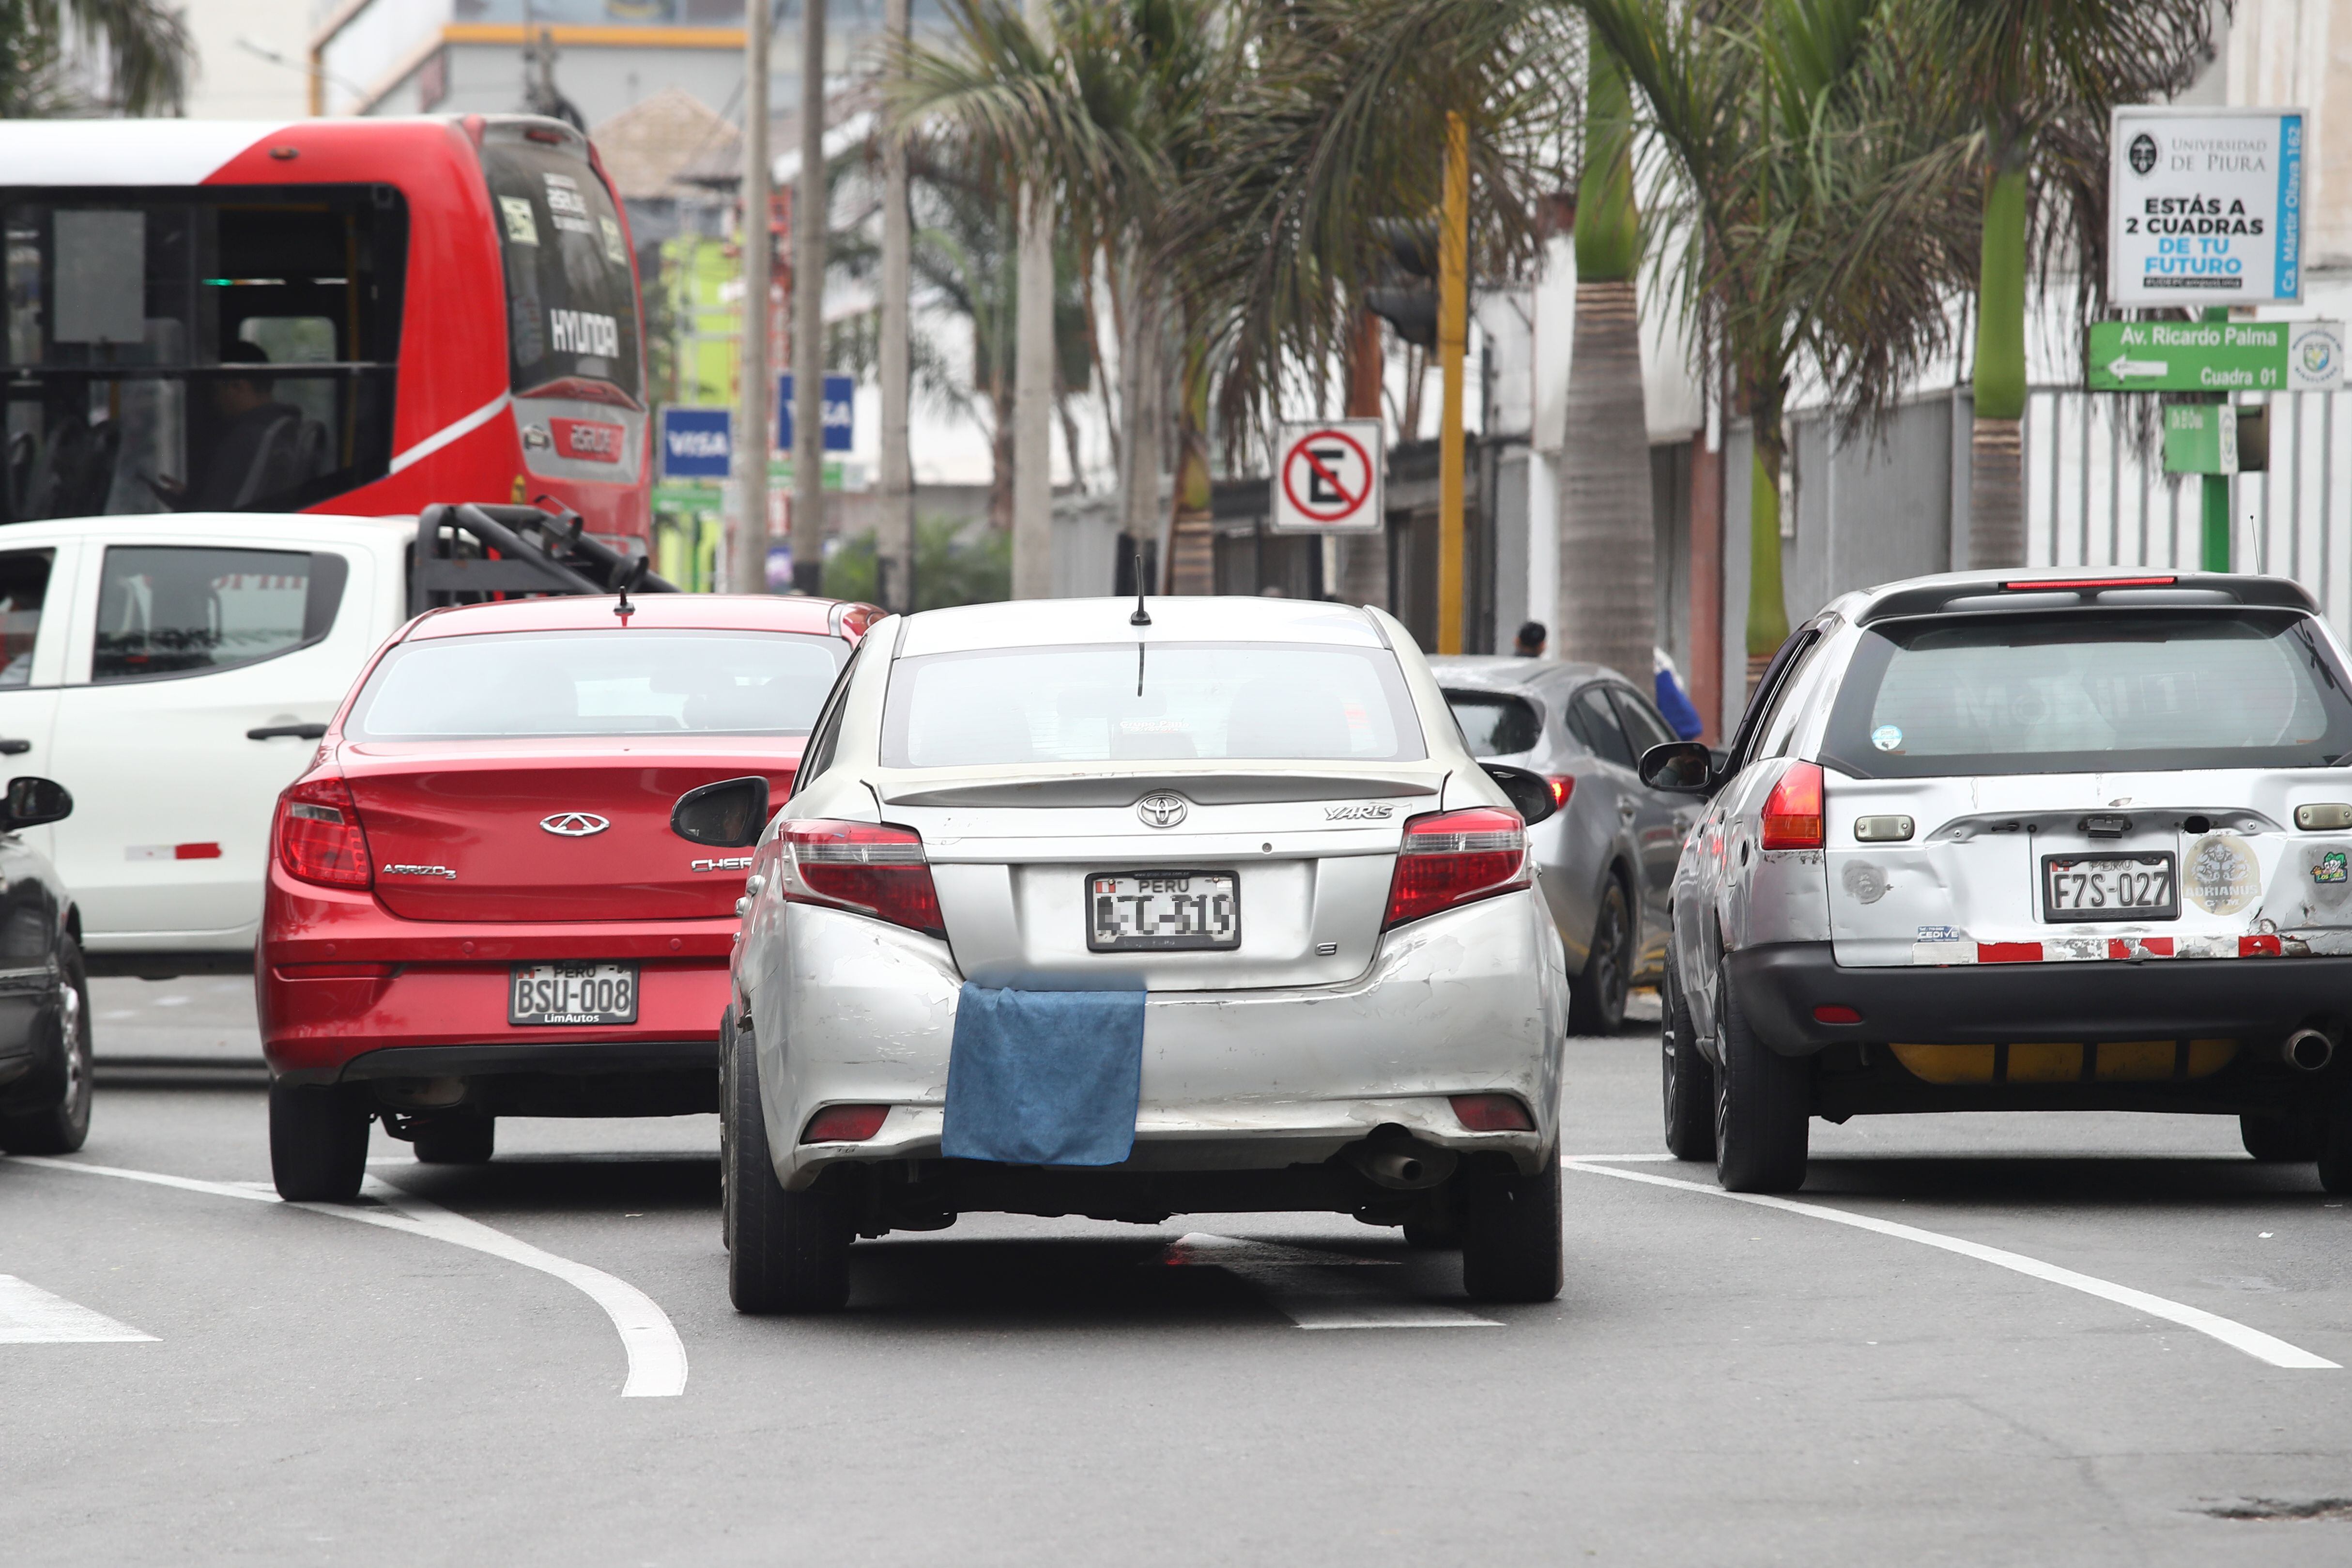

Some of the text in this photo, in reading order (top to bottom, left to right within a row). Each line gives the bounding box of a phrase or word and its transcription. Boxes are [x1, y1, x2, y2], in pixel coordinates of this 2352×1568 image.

[2172, 138, 2267, 152] UNIVERSIDAD
[2287, 125, 2300, 156] 162
[2172, 154, 2266, 171] DE PIURA
[2145, 193, 2245, 214] ESTÁS A
[2126, 218, 2263, 234] 2 CUADRAS
[2159, 238, 2229, 254] DE TU
[2145, 258, 2242, 274] FUTURO
[550, 308, 619, 359] HYUNDAI
[2121, 326, 2147, 345] Av.
[2153, 326, 2220, 346] Ricardo
[2225, 327, 2277, 346] Palma
[2201, 368, 2277, 385] Cuadra 01
[784, 400, 851, 427] VSA
[669, 431, 726, 457] VISA
[1310, 450, 1344, 502] E
[691, 857, 753, 872] CHER
[1139, 879, 1189, 893] PERU
[2054, 872, 2169, 908] F7S-027
[2185, 885, 2258, 897] ADRIANUS
[1919, 927, 1959, 938] CEDIVE
[1315, 942, 1337, 956] E
[518, 979, 630, 1013] BSU-008
[544, 1014, 600, 1023] LimAutos
